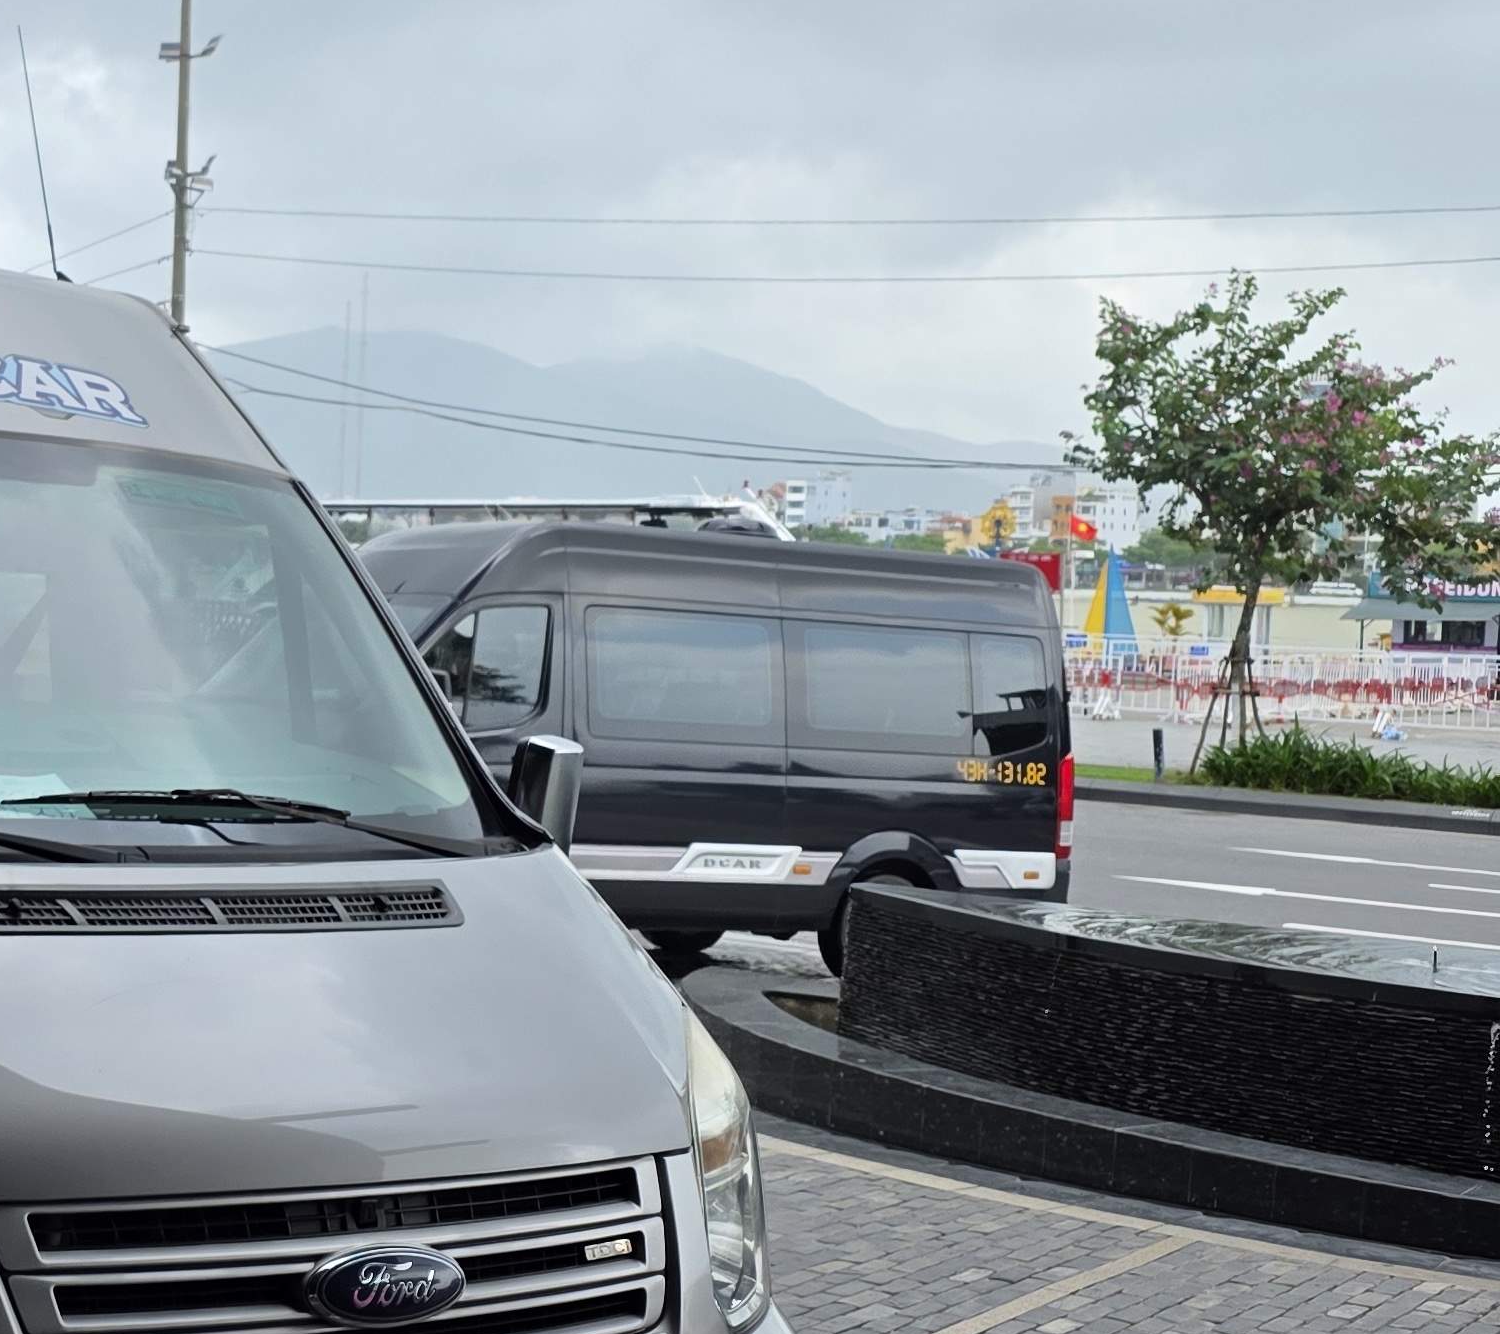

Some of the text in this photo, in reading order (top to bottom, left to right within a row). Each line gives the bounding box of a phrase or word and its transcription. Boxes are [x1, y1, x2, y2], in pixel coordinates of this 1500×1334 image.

[1404, 576, 1500, 597] EIDON
[957, 760, 1047, 786] 43H-131.82
[703, 858, 762, 869] DCAR
[353, 1261, 436, 1309] Ford
